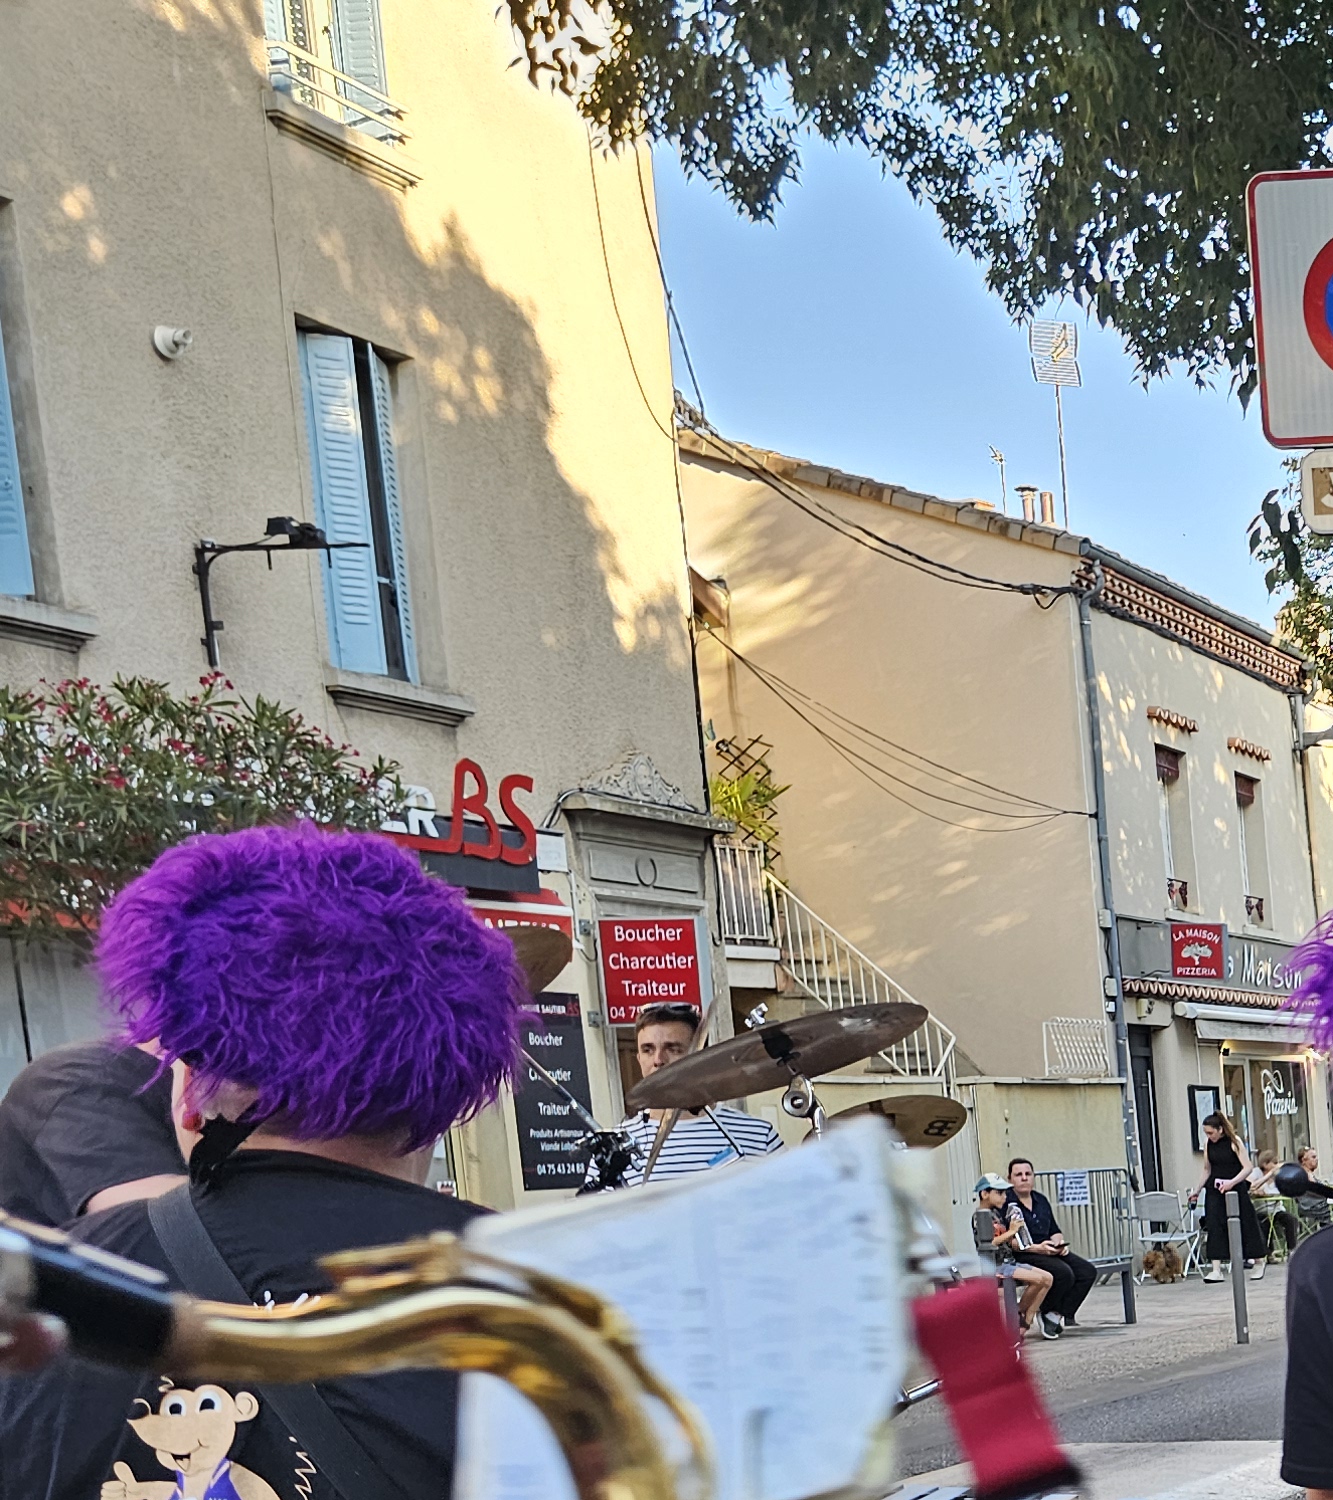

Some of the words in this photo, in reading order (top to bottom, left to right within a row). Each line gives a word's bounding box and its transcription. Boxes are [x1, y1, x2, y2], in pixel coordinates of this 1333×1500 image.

[451, 757, 534, 866] BS
[614, 924, 683, 942] Boucher
[1172, 932, 1183, 942] LA
[1186, 928, 1220, 945] MAISON
[608, 952, 695, 970] Charcutier
[1242, 943, 1302, 990] Maison
[1176, 966, 1217, 977] PIZZERIA
[621, 979, 687, 997] Traiteur
[609, 1006, 626, 1019] 04
[528, 1032, 563, 1047] Boucher
[537, 1102, 570, 1115] Traiteur
[529, 1128, 553, 1138] Produits
[536, 1163, 547, 1175] 04
[548, 1163, 556, 1175] 75
